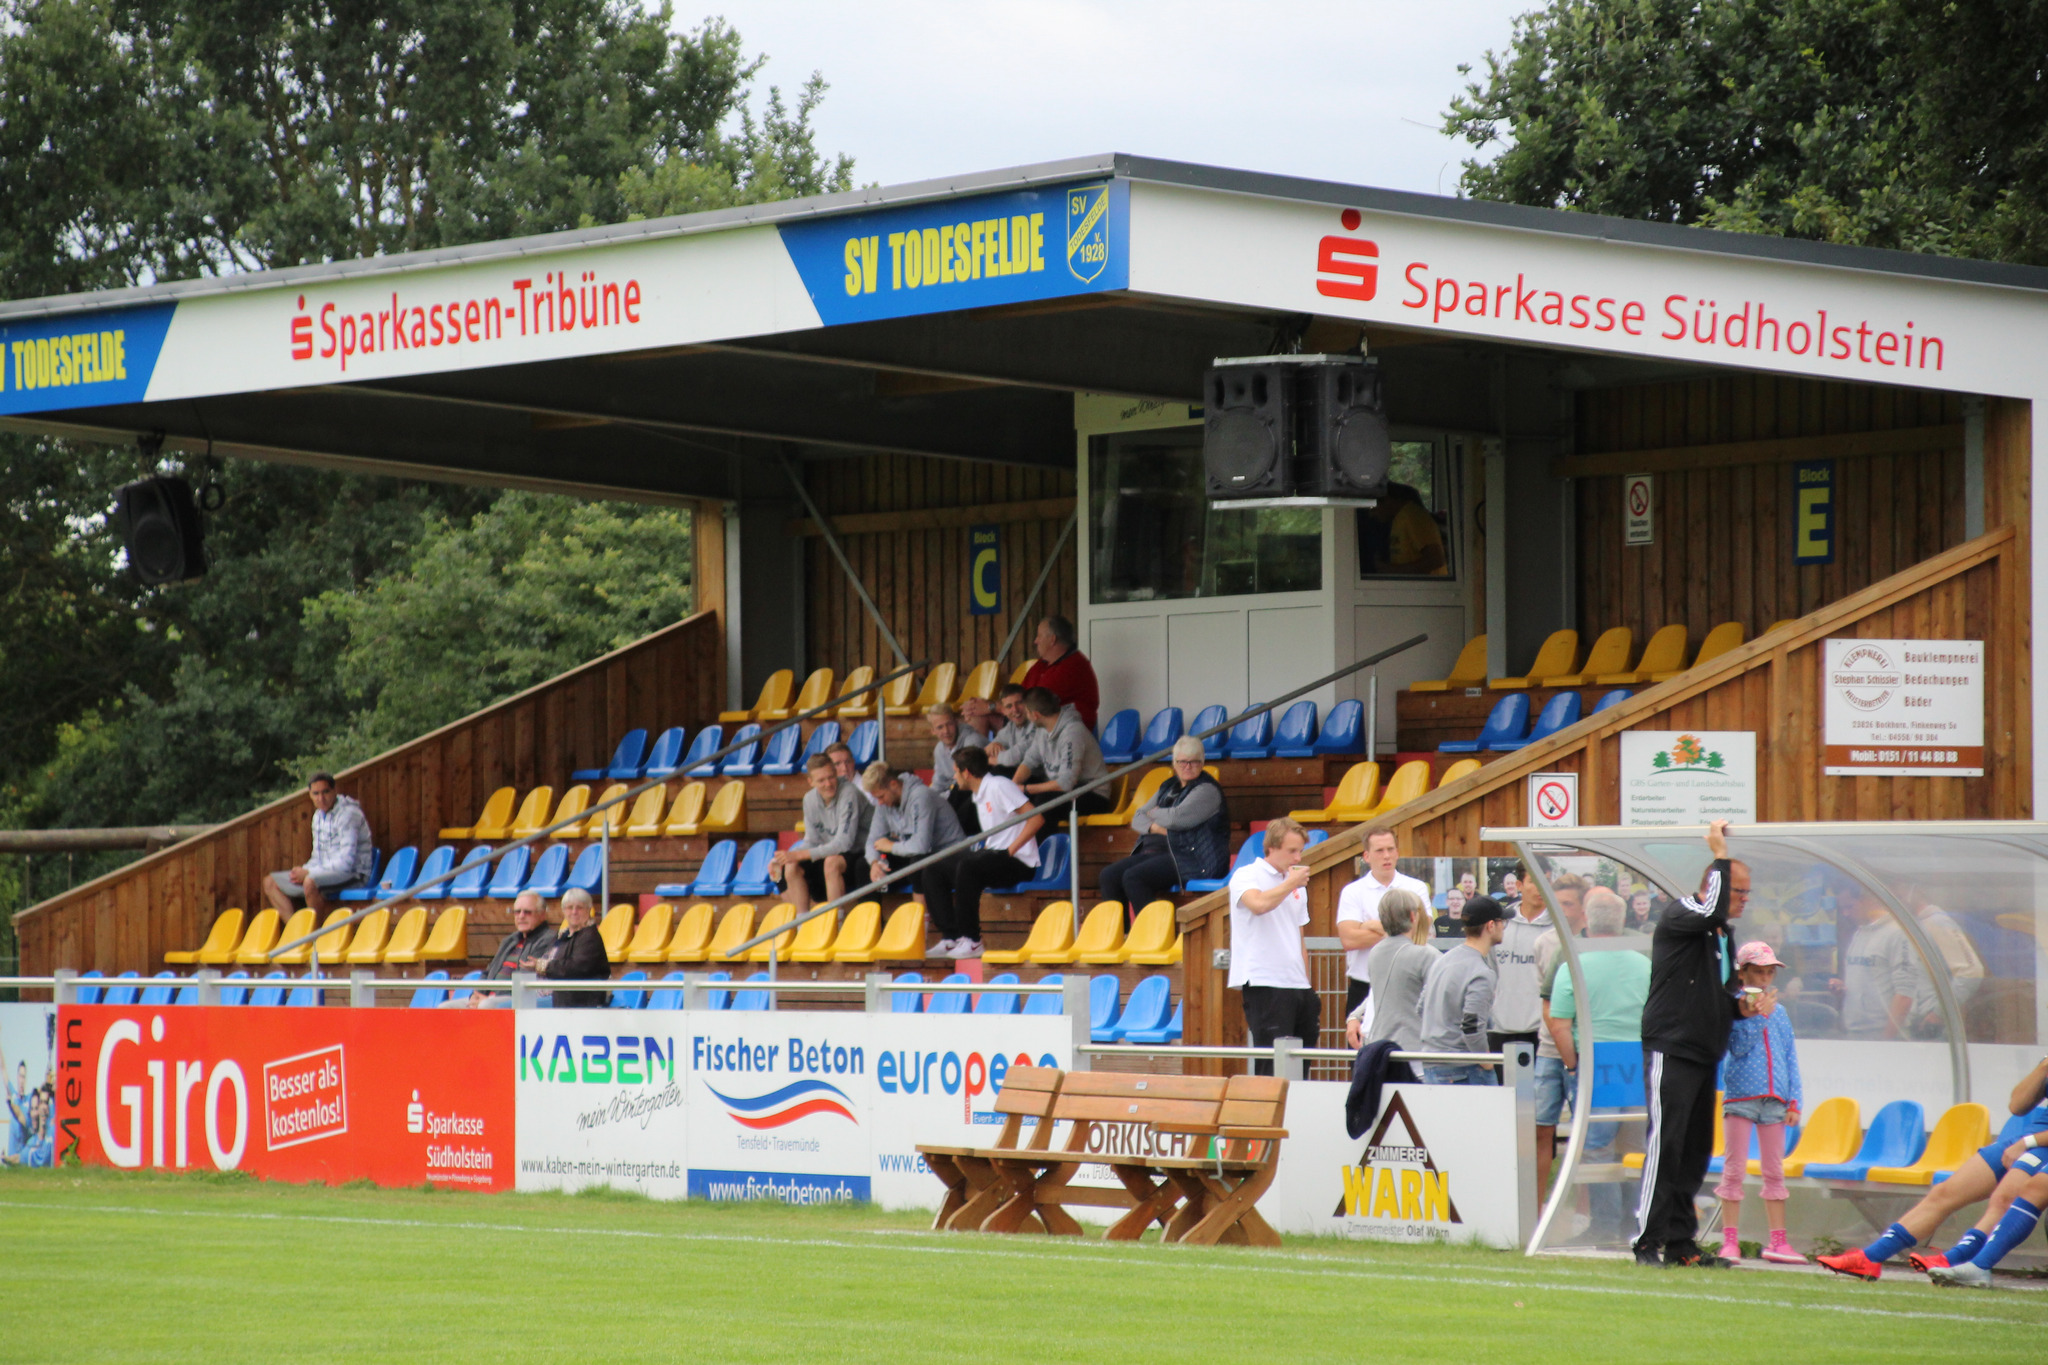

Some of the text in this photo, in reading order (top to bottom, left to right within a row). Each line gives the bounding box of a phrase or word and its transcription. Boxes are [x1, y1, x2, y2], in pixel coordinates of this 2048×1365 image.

[1070, 196, 1106, 250] TODESFELDE
[1071, 195, 1087, 215] SV
[844, 212, 1045, 296] SV TODESFELDE
[1080, 242, 1105, 263] 1928
[319, 270, 641, 372] Sparkassen-Tribüne
[1402, 261, 1945, 371] Sparkasse Südholstein
[12, 329, 126, 391] TODESFELDE
[1799, 468, 1830, 483] Block
[1797, 487, 1829, 557] E
[973, 548, 997, 608] C
[1844, 649, 1889, 669] KLEMPNEREI
[1850, 750, 1878, 762] Mobil:
[1878, 750, 1900, 762] 0151
[520, 1034, 674, 1084] KABEN
[692, 1036, 865, 1075] Fischer Beton
[60, 1018, 82, 1163] Mein
[95, 1014, 248, 1172] Giro
[269, 1058, 338, 1102] Besser als
[271, 1095, 341, 1138] kostenlos!
[426, 1111, 484, 1139] Sparkasse
[576, 1078, 684, 1131] mein Wintergarten
[426, 1144, 493, 1170] Südholstein
[521, 1155, 680, 1182] www.kaben-mein-wintergarten.de
[1368, 1145, 1428, 1162] ZIMMEREI
[708, 1175, 854, 1205] www.fischerbetonde
[1341, 1165, 1450, 1222] WARN
[1406, 1224, 1424, 1237] Olaf
[1426, 1225, 1450, 1238] Warn
